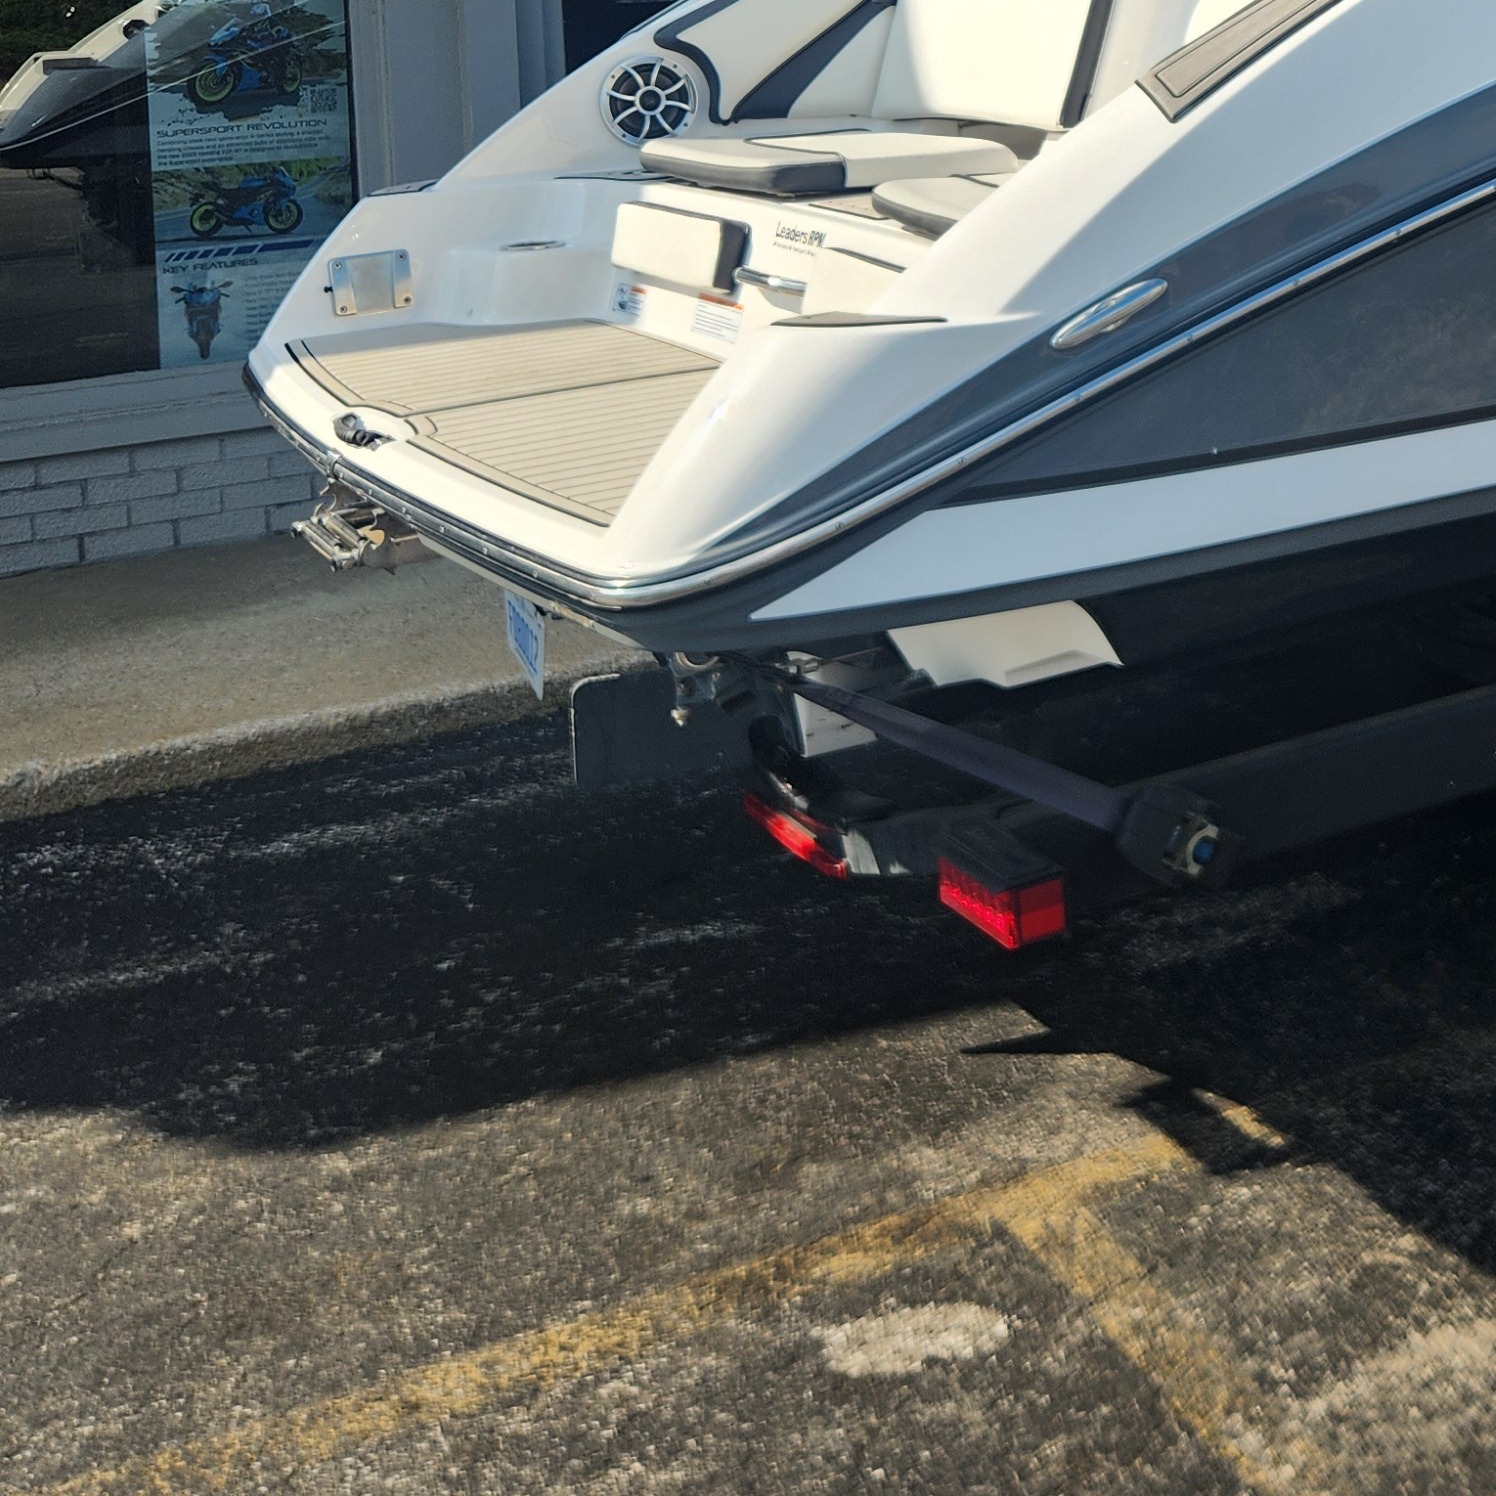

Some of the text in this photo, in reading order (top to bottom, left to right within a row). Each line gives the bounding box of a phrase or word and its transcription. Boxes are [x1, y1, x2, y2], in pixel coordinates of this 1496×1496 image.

[156, 124, 242, 139] SUPERSPORT
[246, 118, 328, 132] REVOLUTION
[775, 220, 808, 245] Leaders
[162, 257, 259, 275] KEY FEATURES
